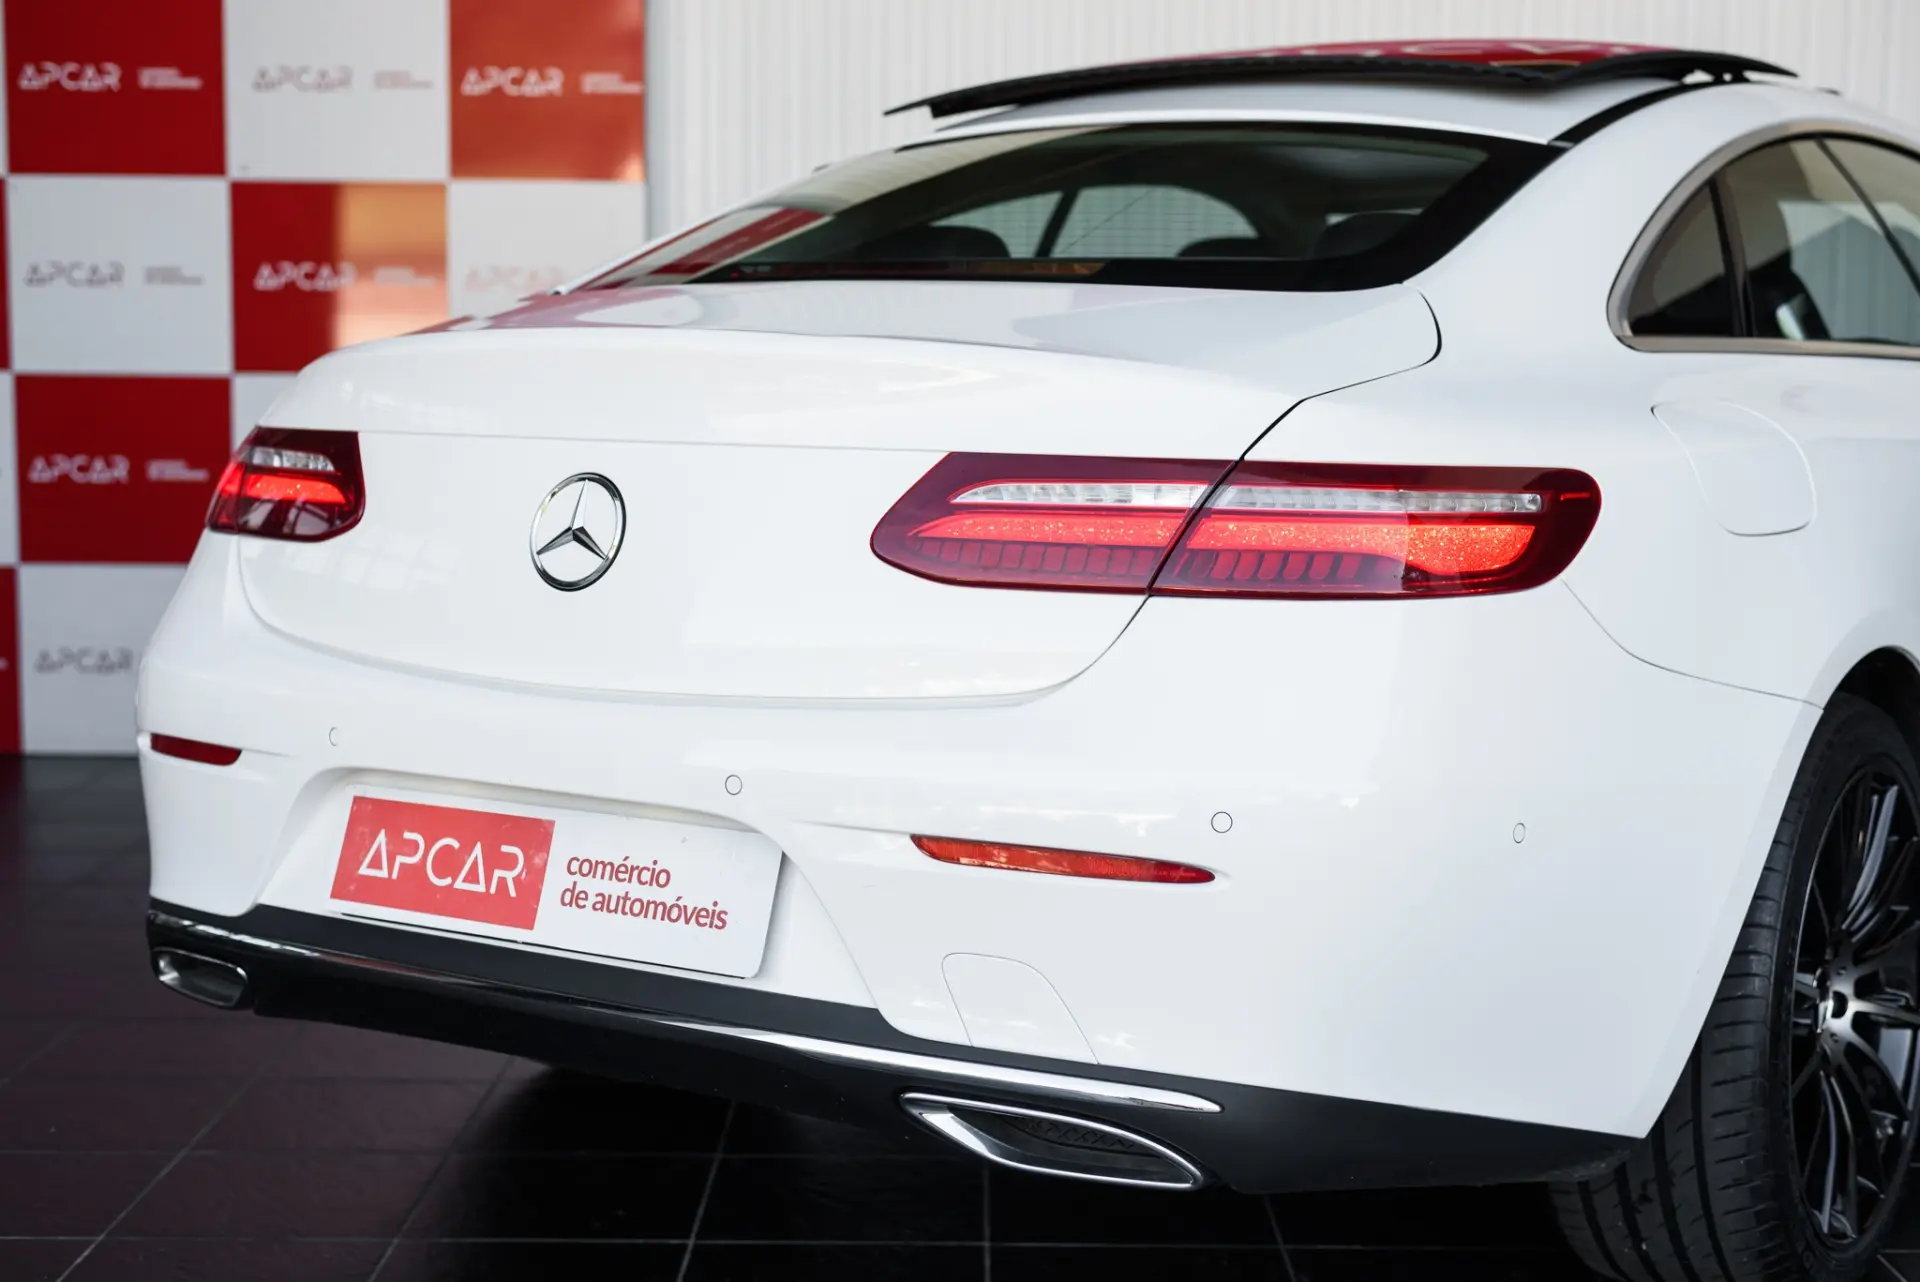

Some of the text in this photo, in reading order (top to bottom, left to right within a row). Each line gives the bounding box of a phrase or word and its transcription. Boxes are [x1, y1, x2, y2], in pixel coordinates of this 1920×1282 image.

[17, 61, 121, 91] APCAR
[252, 64, 353, 93] APCAR
[460, 65, 564, 97] APCAR
[24, 260, 125, 288] APCAR
[253, 260, 356, 291] APCAR
[29, 454, 129, 484] APCAR
[34, 647, 134, 674] APCAR
[358, 828, 525, 898] APCAR
[566, 855, 672, 889] comércio
[560, 881, 728, 930] de automóveis
